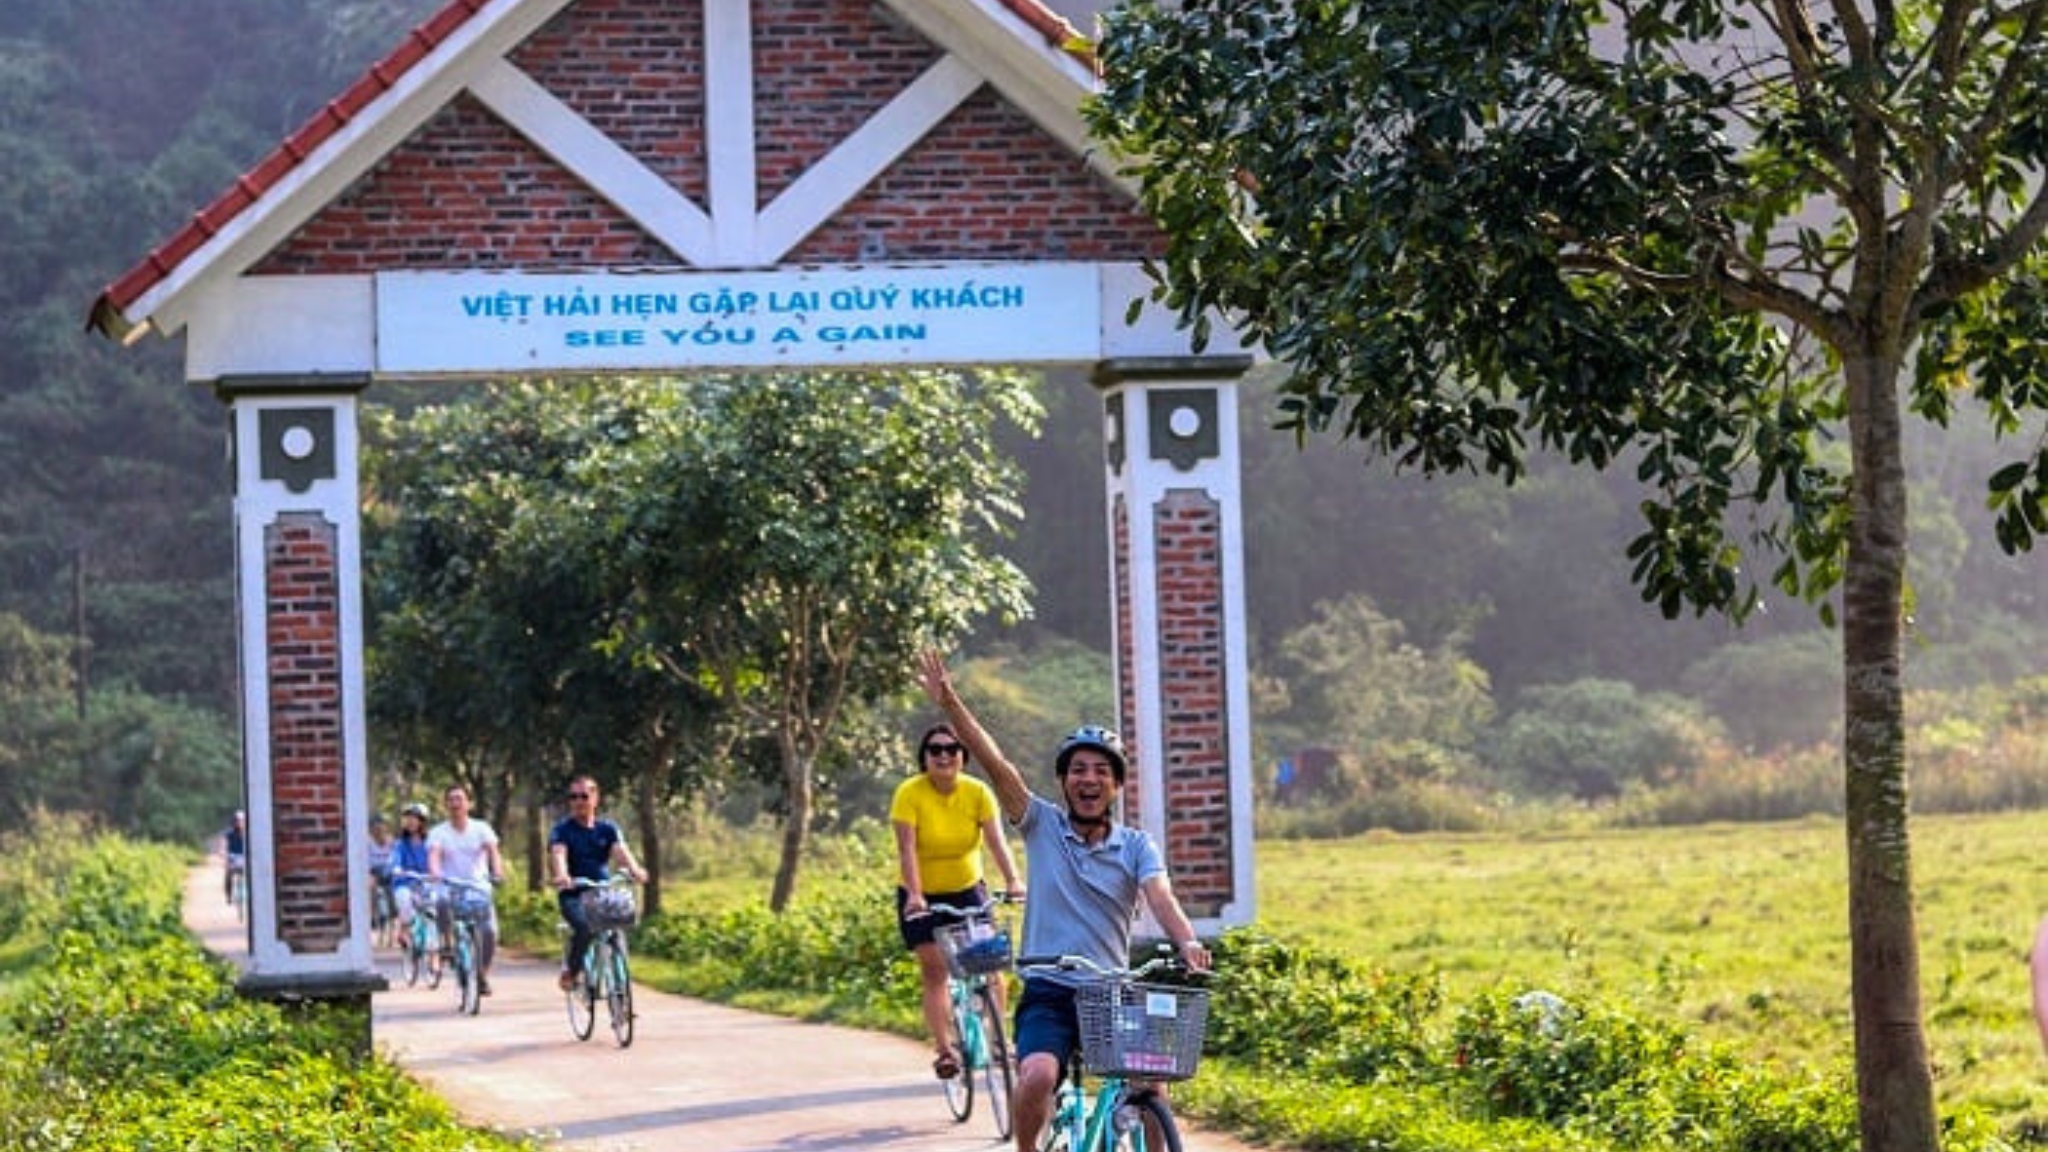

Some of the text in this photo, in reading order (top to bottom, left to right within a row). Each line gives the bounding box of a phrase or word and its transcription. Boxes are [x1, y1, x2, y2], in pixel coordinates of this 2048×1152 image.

[461, 290, 533, 322] VIỆT
[543, 286, 600, 316] HẢI
[611, 293, 678, 321] HẸN
[911, 280, 1023, 309] KHÁCH
[564, 324, 927, 346] SEE YOU A GAIN
